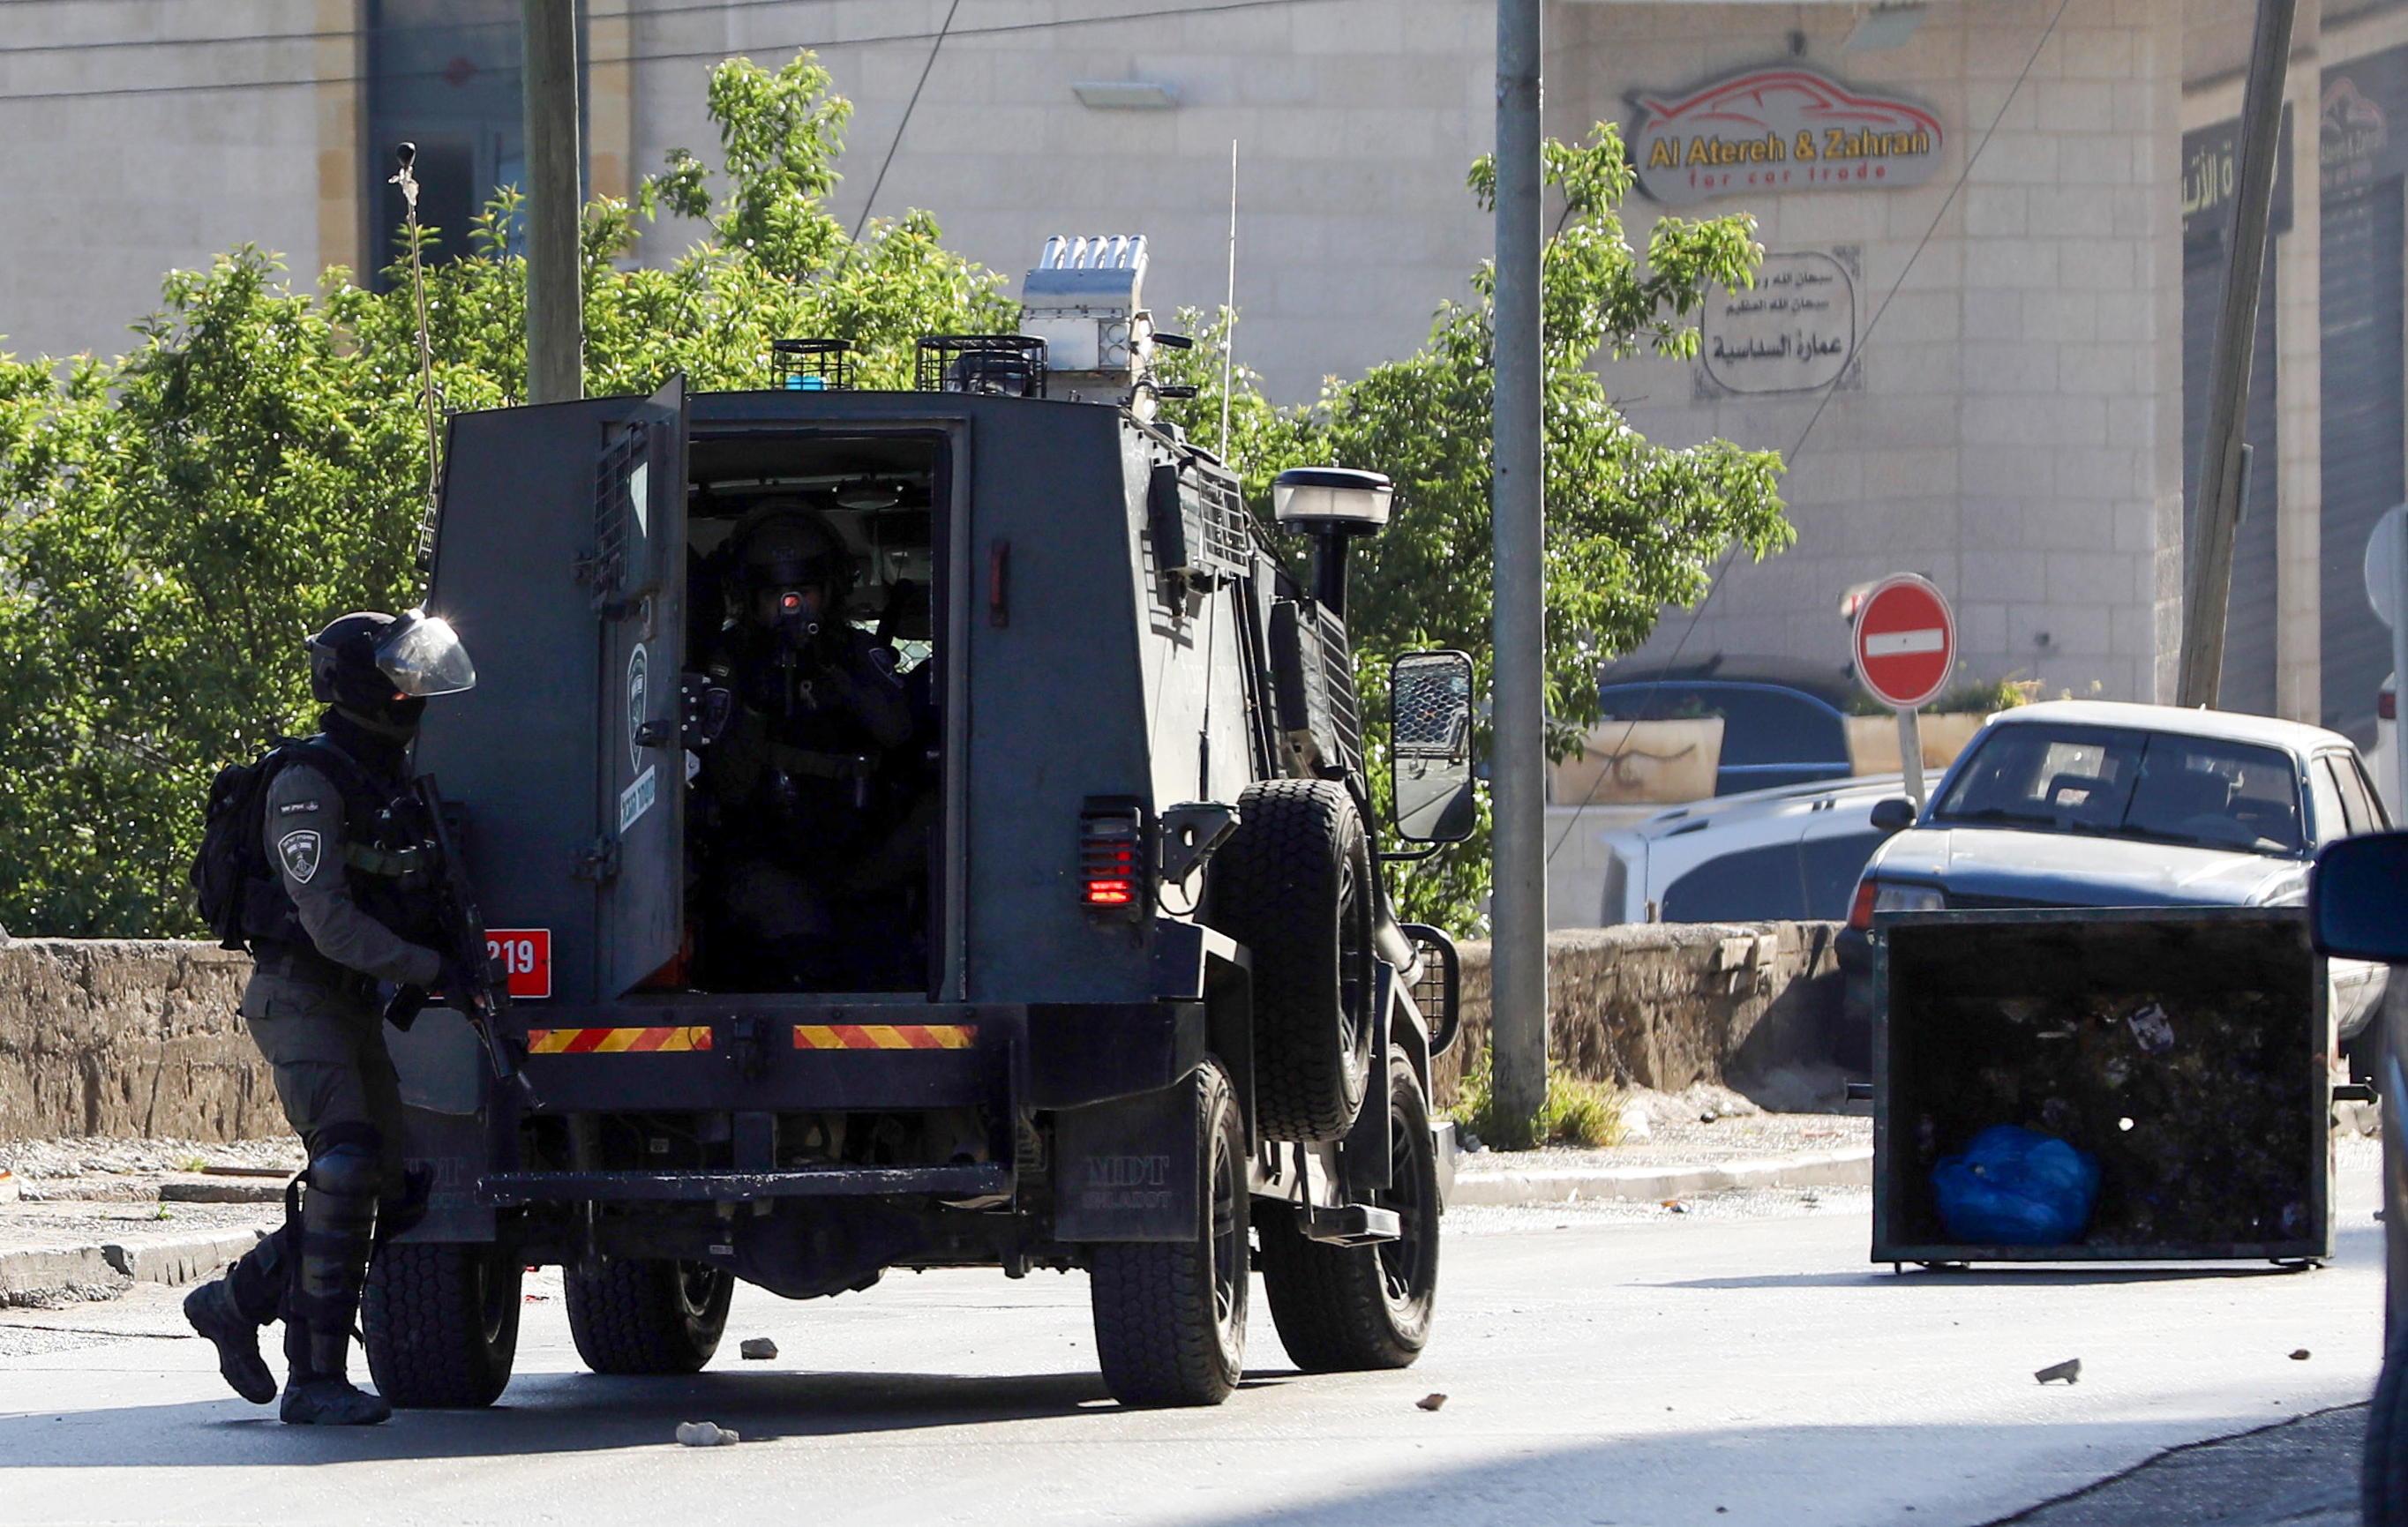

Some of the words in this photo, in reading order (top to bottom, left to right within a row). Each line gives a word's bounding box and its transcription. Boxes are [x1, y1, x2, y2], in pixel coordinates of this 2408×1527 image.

[1647, 137, 1679, 170] Al
[1685, 132, 1786, 168] Atereh
[1795, 130, 1817, 161] &
[1824, 125, 1930, 160] Zahran
[1690, 168, 1730, 188] for
[1773, 271, 1793, 285] الله
[1769, 297, 1789, 311] الله
